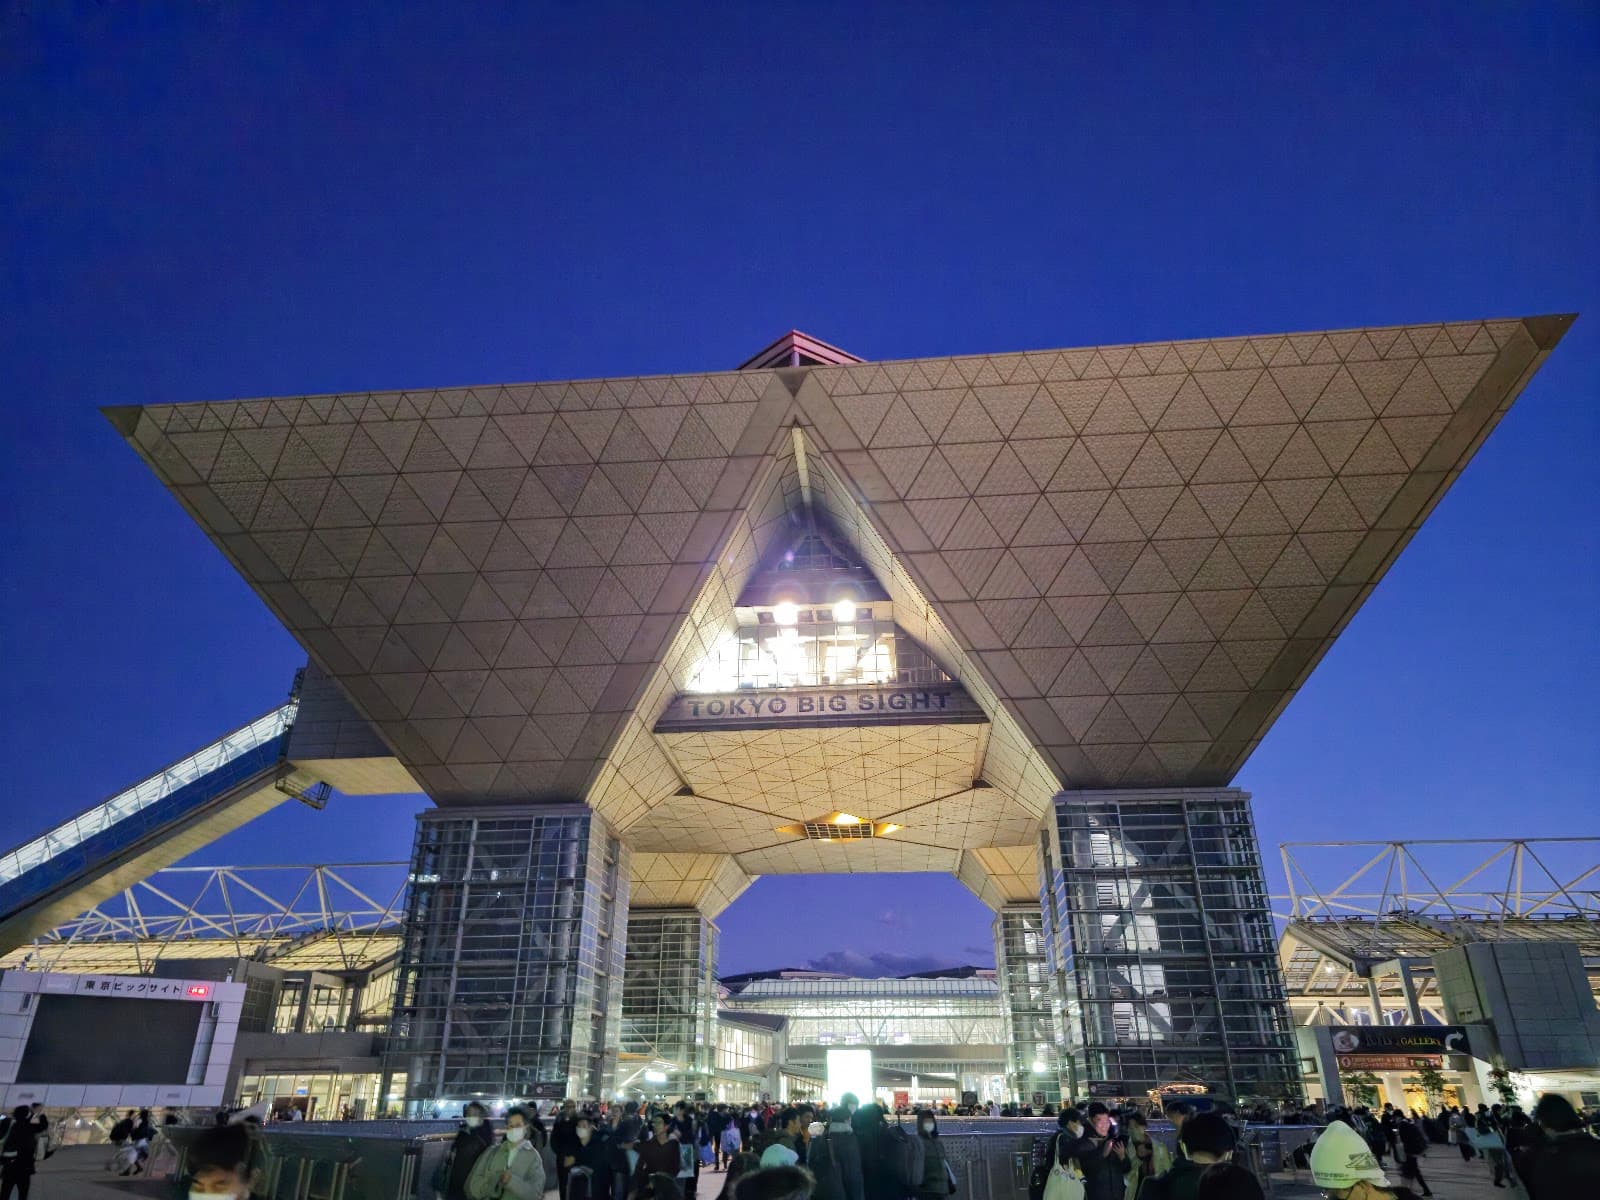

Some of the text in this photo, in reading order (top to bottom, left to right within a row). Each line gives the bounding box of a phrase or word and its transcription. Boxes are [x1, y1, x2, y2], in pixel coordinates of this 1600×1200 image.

[687, 691, 950, 717] TOKYO BIG SIGHT
[85, 980, 180, 993] 東京ビッグサイト
